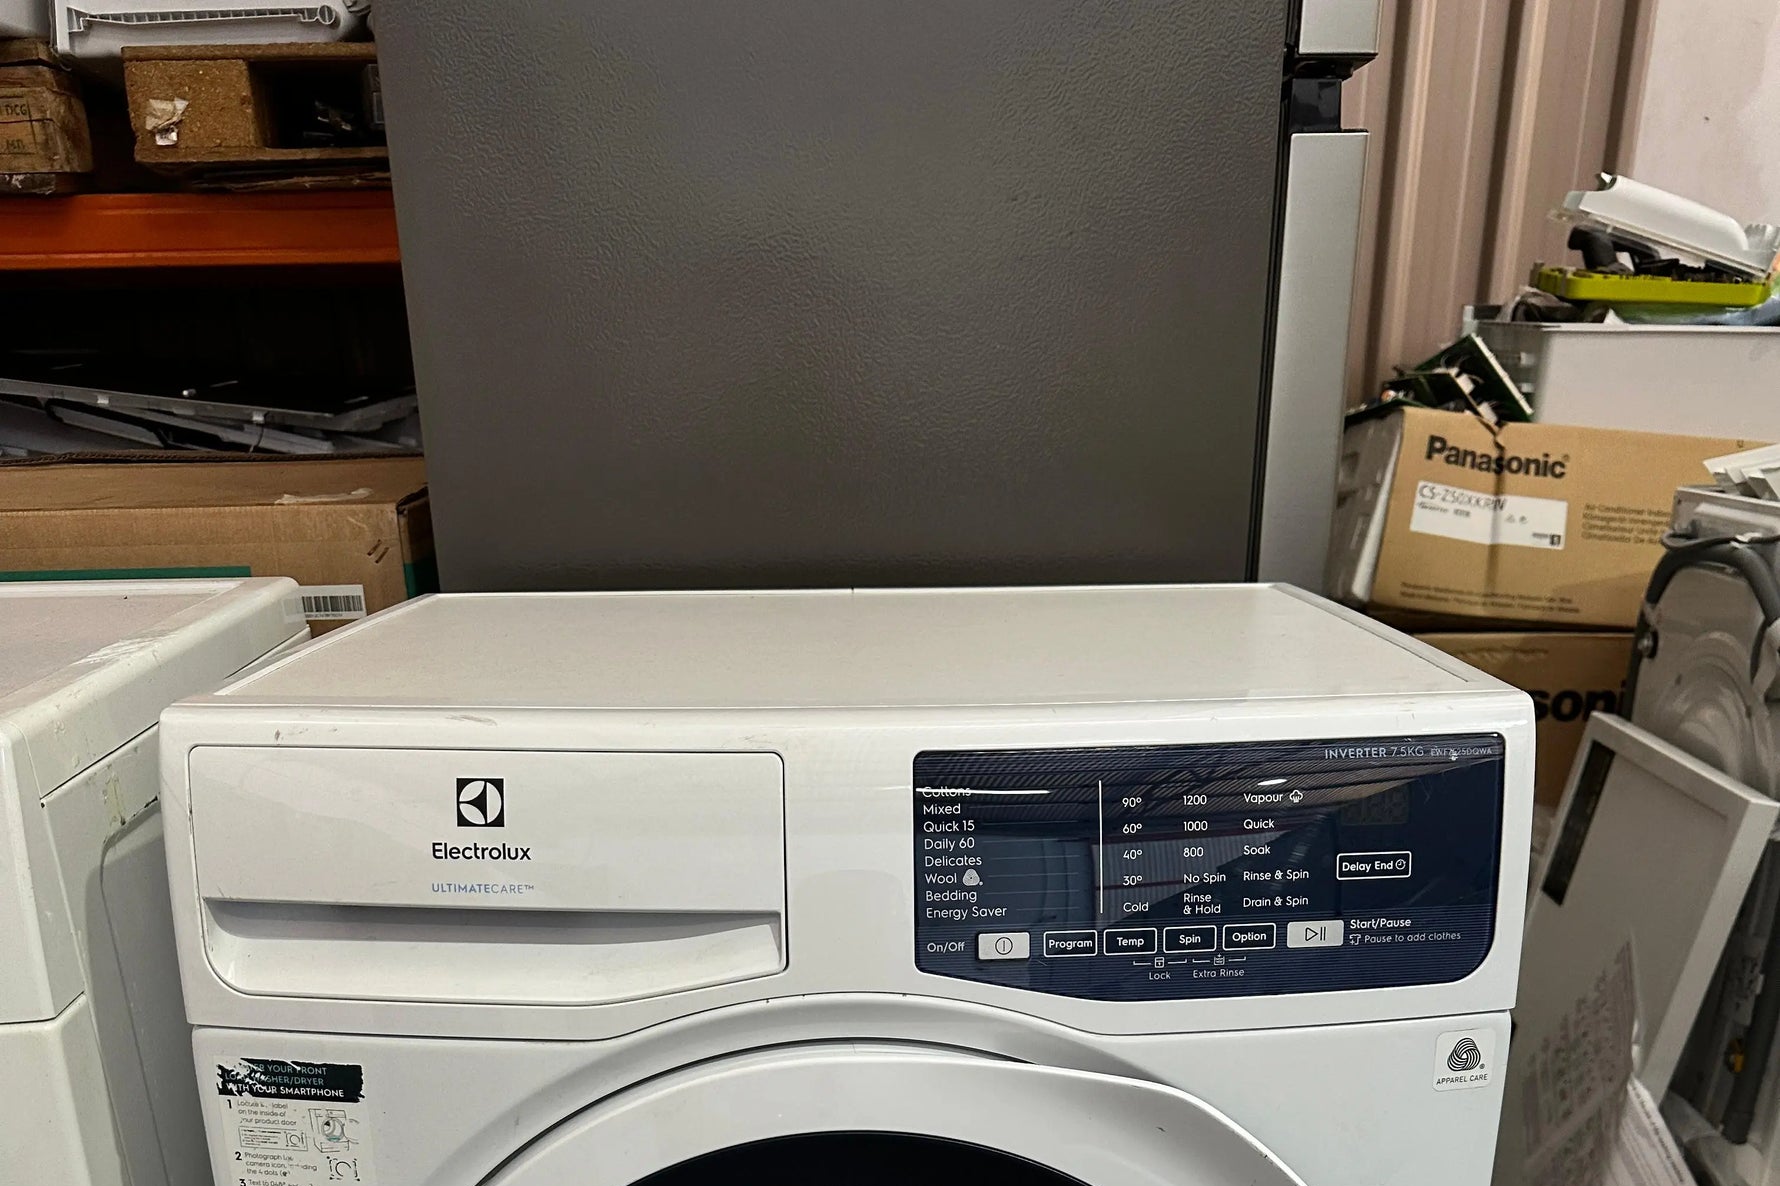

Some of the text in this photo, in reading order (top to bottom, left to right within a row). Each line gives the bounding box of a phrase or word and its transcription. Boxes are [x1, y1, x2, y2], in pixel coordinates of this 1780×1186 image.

[1425, 434, 1566, 479] Panasonic
[1325, 747, 1387, 760] INVERTER
[1390, 746, 1424, 758] 7.5KG
[1183, 795, 1207, 805] 1200
[1243, 793, 1283, 805] Vapour
[923, 803, 961, 815] Mixed
[923, 820, 975, 833] Quick 15
[1183, 821, 1208, 831] 1000
[1243, 818, 1275, 830] Quick
[924, 837, 975, 852] Daily 60
[1243, 845, 1271, 855] Soak
[432, 842, 532, 861] Electrolux
[1183, 847, 1204, 857] 800
[925, 855, 982, 867] Delicates
[1342, 860, 1394, 873] Delay End
[925, 873, 957, 884] Wool
[1183, 872, 1226, 884] No Spin
[1243, 869, 1310, 881] Rinse & Spin
[926, 890, 977, 902] Bedding
[1183, 893, 1212, 903] Rinse
[1243, 896, 1309, 908] Drain & Spin
[926, 905, 1007, 920] Energy Saver
[1123, 902, 1149, 913] Cold
[1183, 903, 1221, 914] & Hold
[1350, 918, 1412, 930] Start/Pause
[1117, 937, 1144, 948] Temp
[1179, 934, 1201, 946] Spin
[1232, 931, 1267, 943] Option
[1364, 931, 1461, 944] Pause to add clothes
[927, 941, 965, 953] On/Off
[1049, 938, 1093, 951] Program
[1149, 970, 1171, 980] Lock
[1193, 968, 1245, 978] Extra Rinse
[267, 1064, 293, 1074] YOUR
[1436, 1073, 1488, 1085] APPAREL CARE
[252, 1085, 277, 1094] YOUR
[280, 1086, 345, 1098] SMARTPHONE
[227, 1099, 232, 1109] 1
[254, 1118, 280, 1126] product
[235, 1151, 243, 1161] 2
[244, 1152, 282, 1161] Photograph
